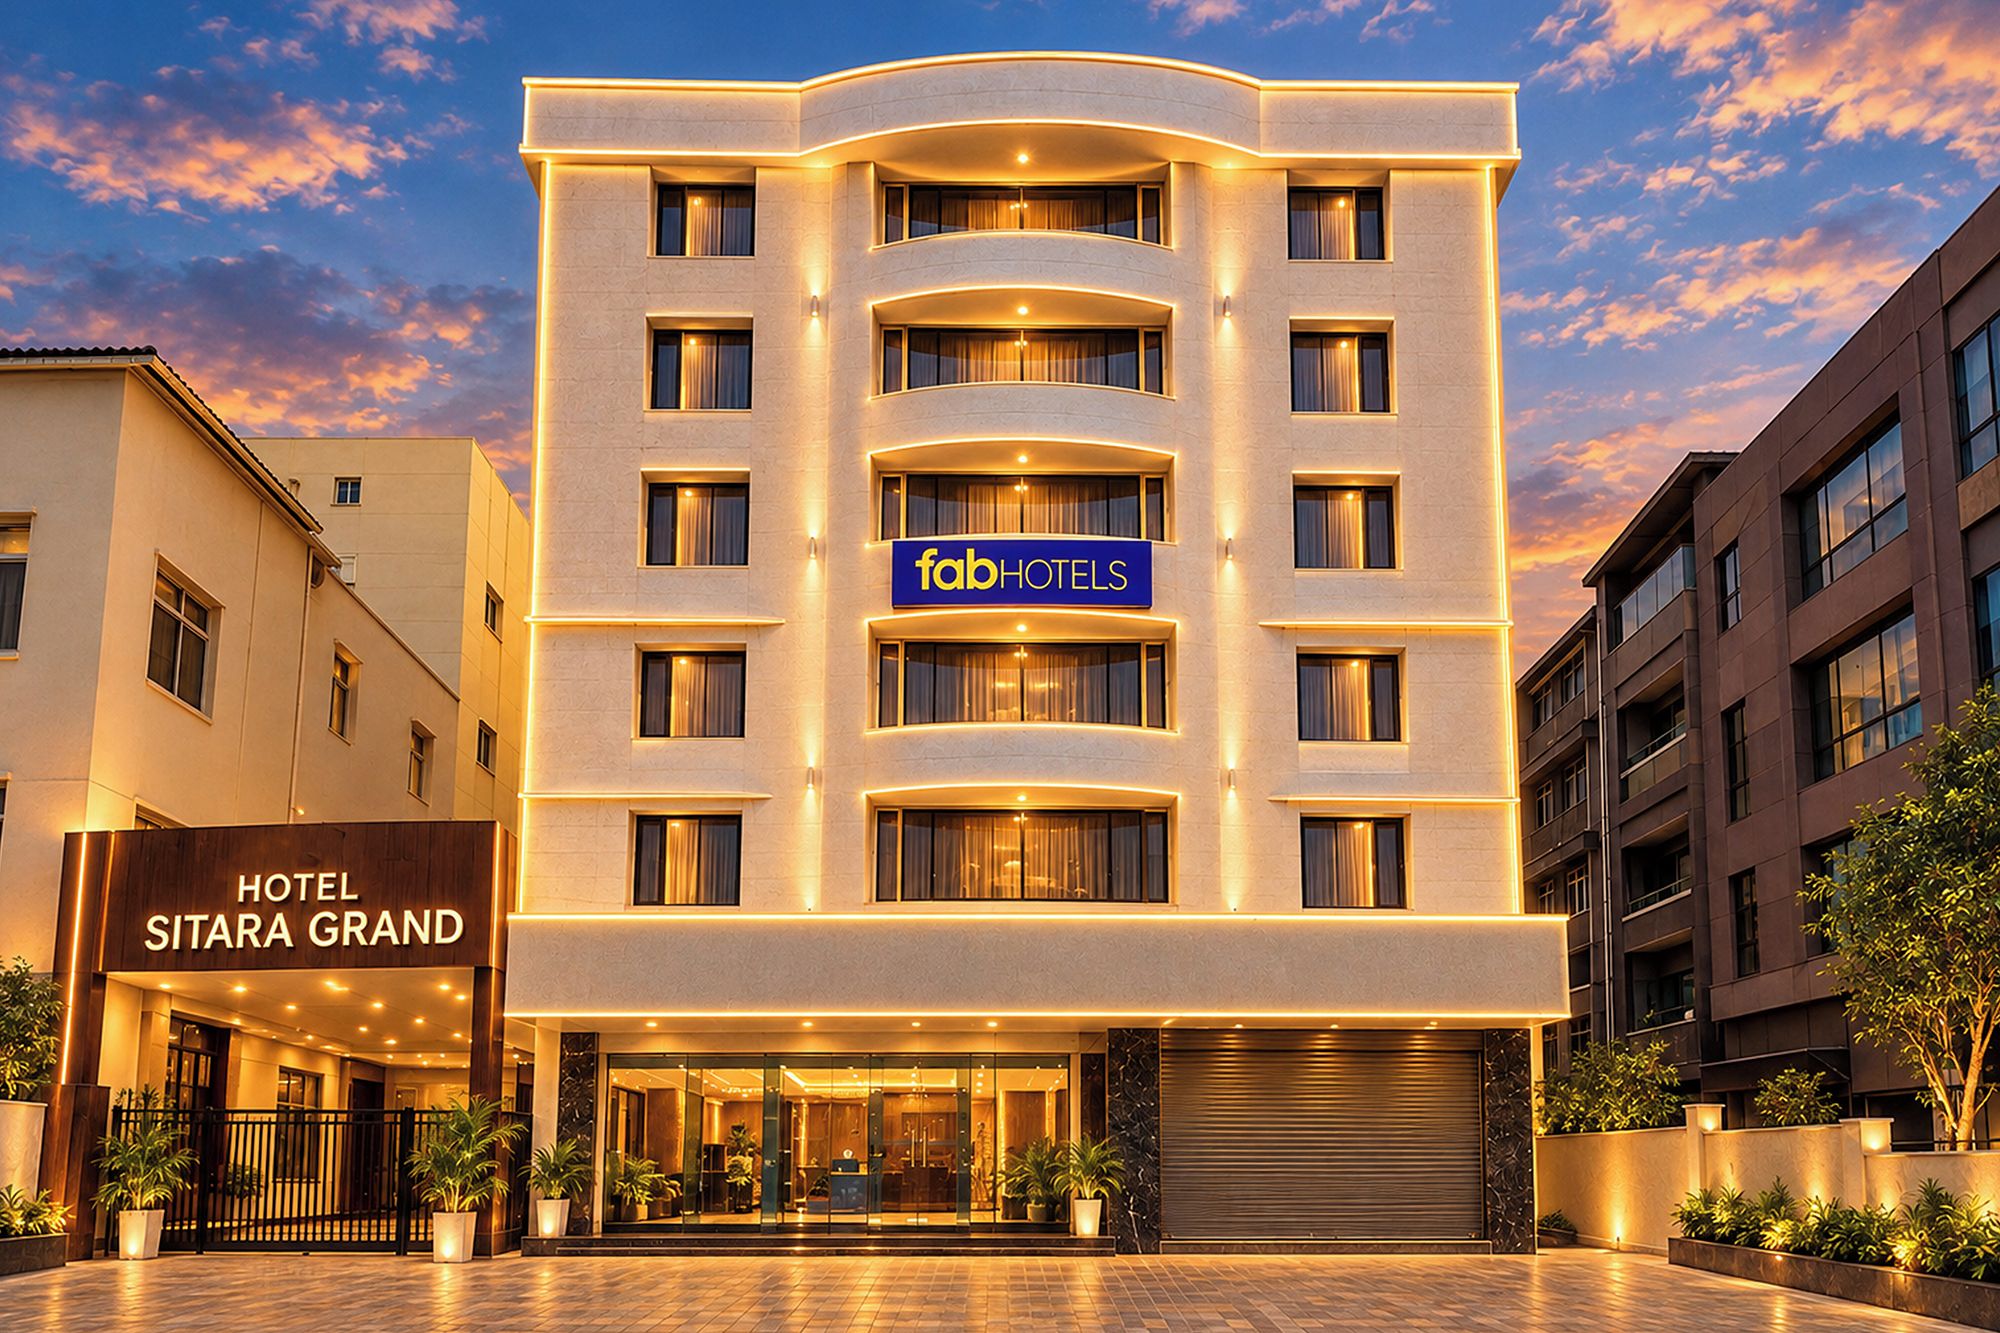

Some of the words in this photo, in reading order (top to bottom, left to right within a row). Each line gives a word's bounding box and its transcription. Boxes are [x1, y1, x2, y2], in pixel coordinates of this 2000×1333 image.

[237, 872, 359, 903] HOTEL
[144, 912, 294, 951] SITARA
[308, 909, 465, 948] GRAND
